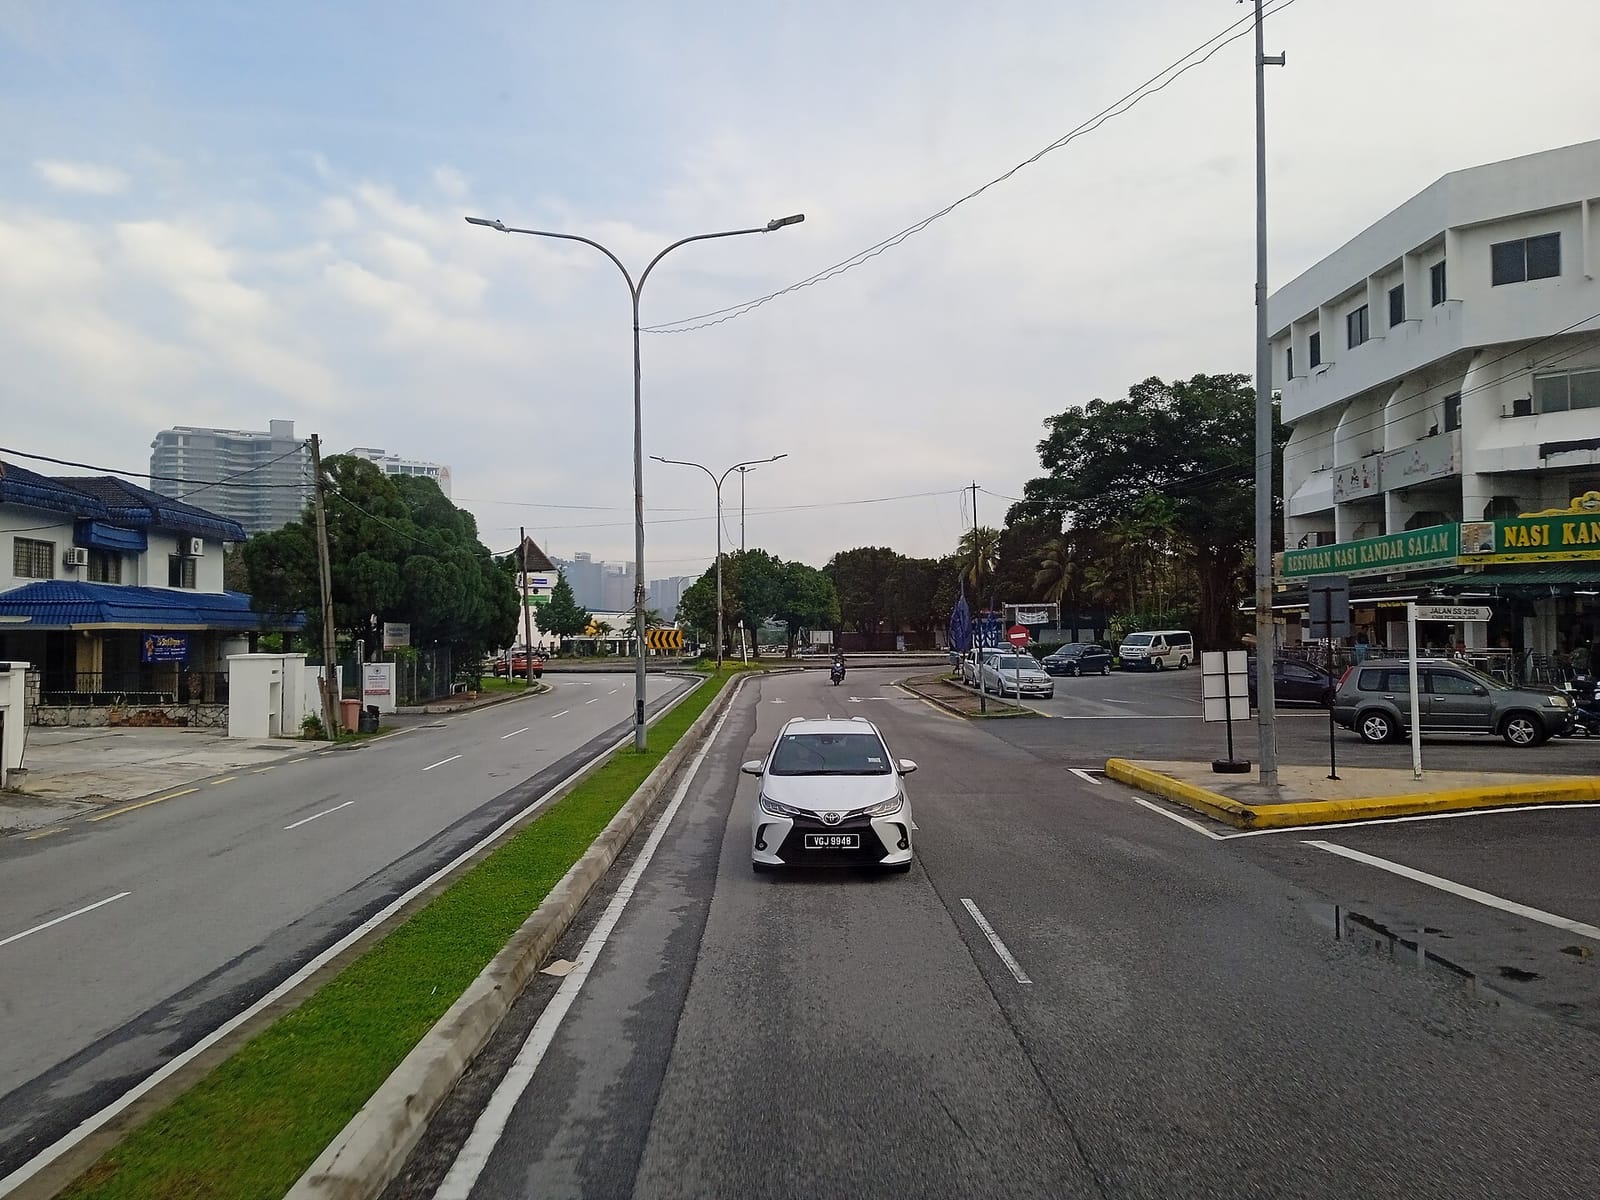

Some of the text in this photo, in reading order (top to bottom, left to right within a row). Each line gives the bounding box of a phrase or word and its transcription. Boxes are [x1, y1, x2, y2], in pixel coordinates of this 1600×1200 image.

[1504, 525, 1550, 547] NASI
[1288, 532, 1449, 572] RESTORAN NASI KANDAR SALAM
[814, 836, 851, 845] VGJ 9948
